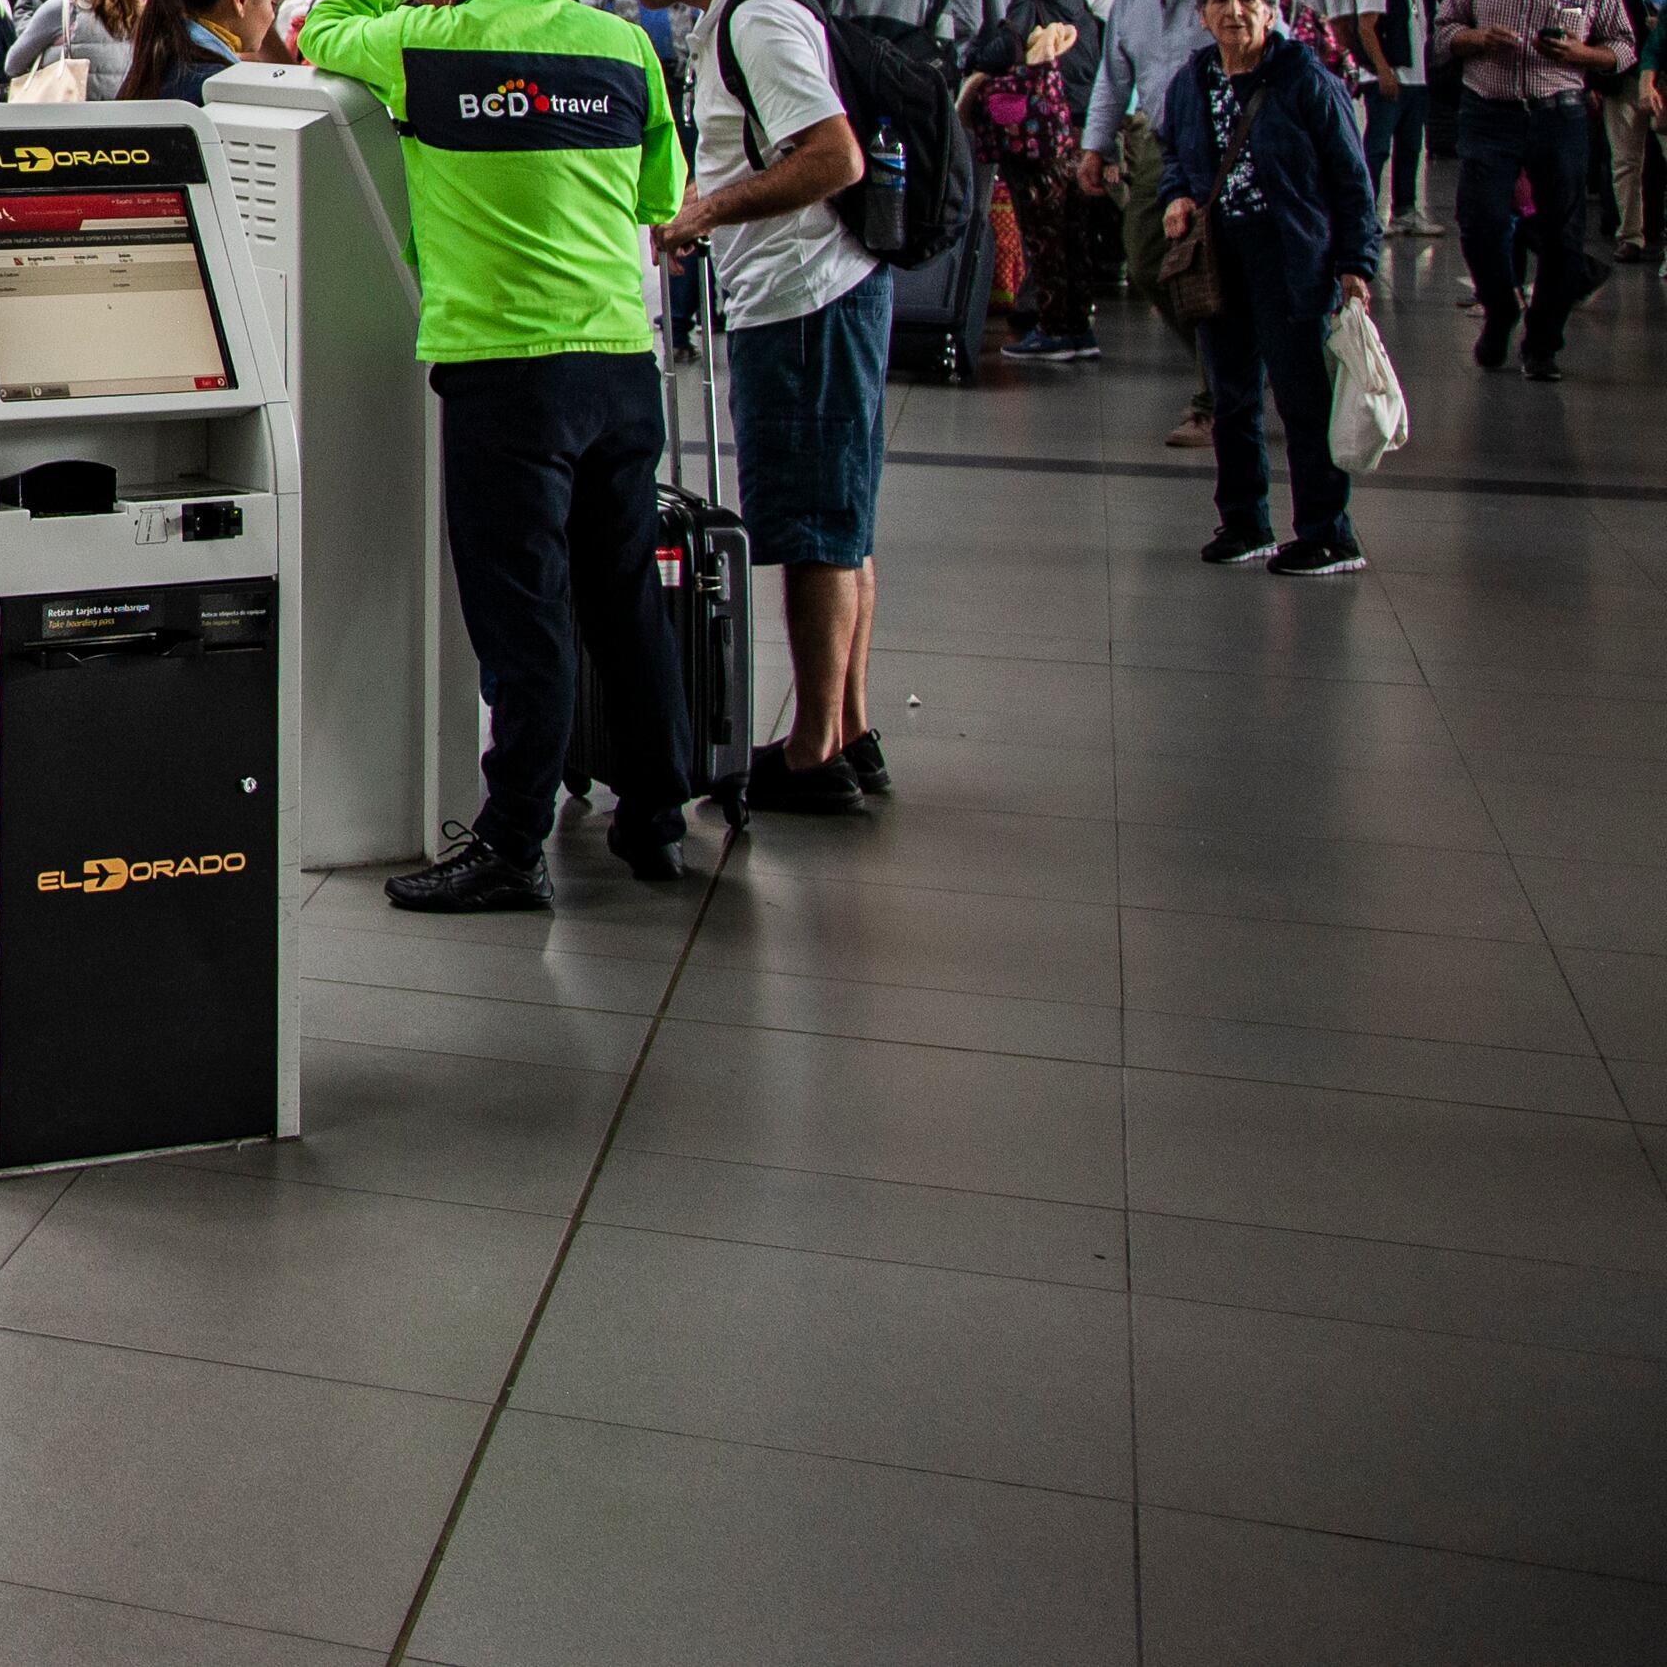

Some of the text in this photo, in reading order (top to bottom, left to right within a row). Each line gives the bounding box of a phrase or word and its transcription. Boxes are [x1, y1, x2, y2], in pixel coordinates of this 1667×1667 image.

[458, 92, 609, 119] BCD travel
[48, 603, 150, 617] Retirar tarjeta de embarque
[48, 620, 65, 629] Take
